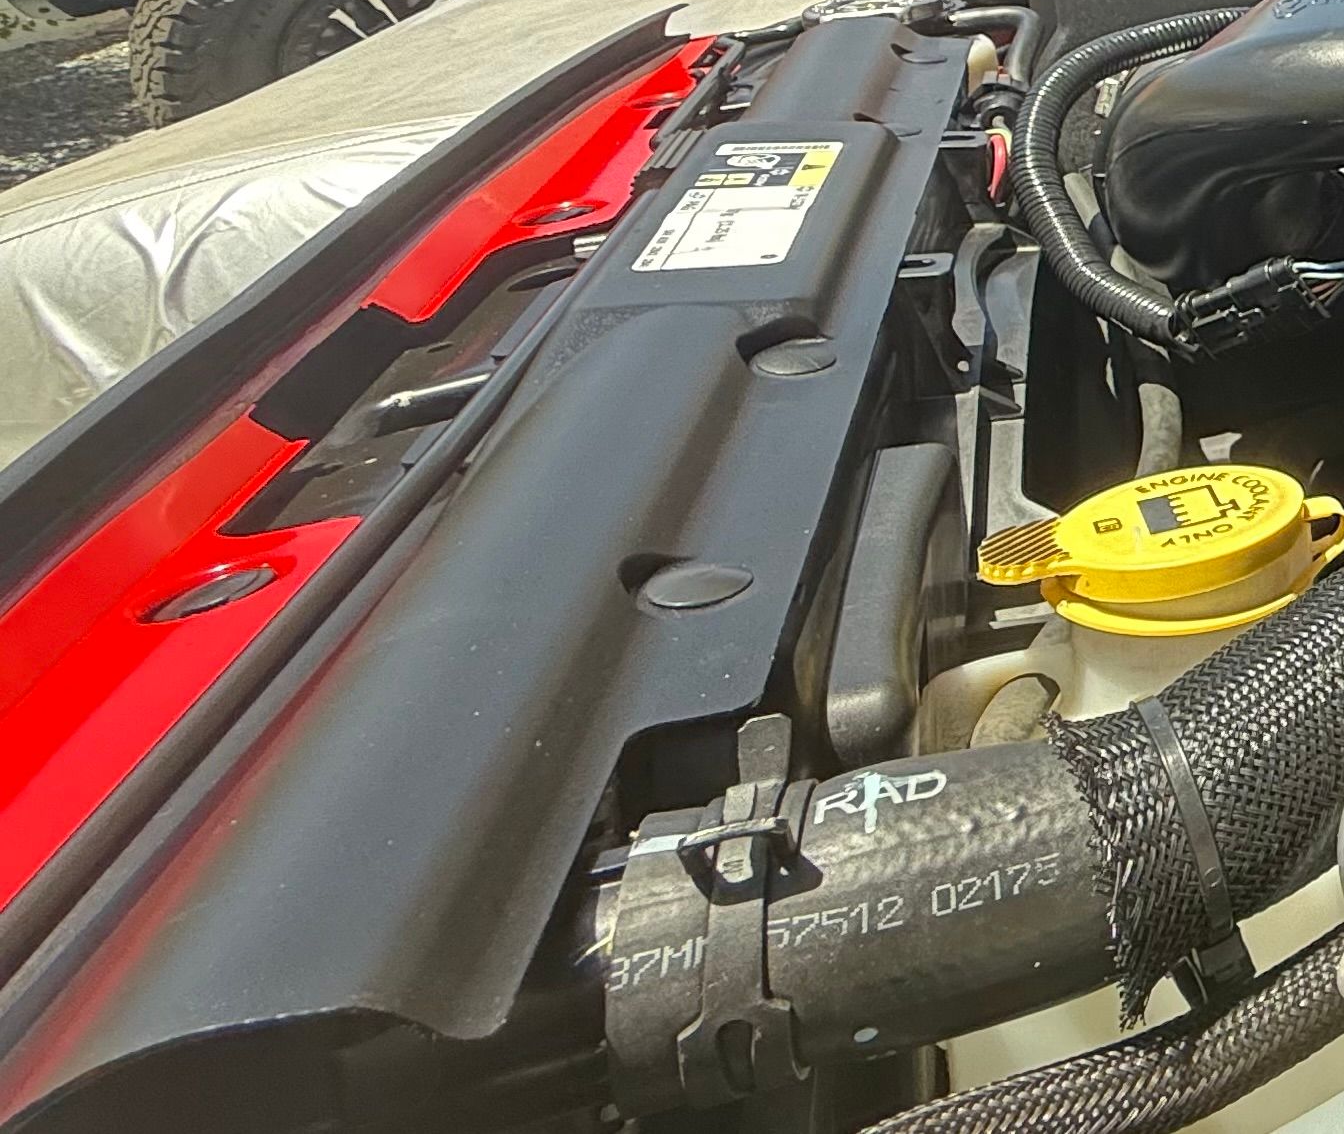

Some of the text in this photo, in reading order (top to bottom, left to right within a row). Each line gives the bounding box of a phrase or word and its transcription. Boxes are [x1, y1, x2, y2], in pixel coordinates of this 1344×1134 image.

[1134, 472, 1271, 548] ENGINE COOLANT ONLY
[813, 769, 947, 825] RAD
